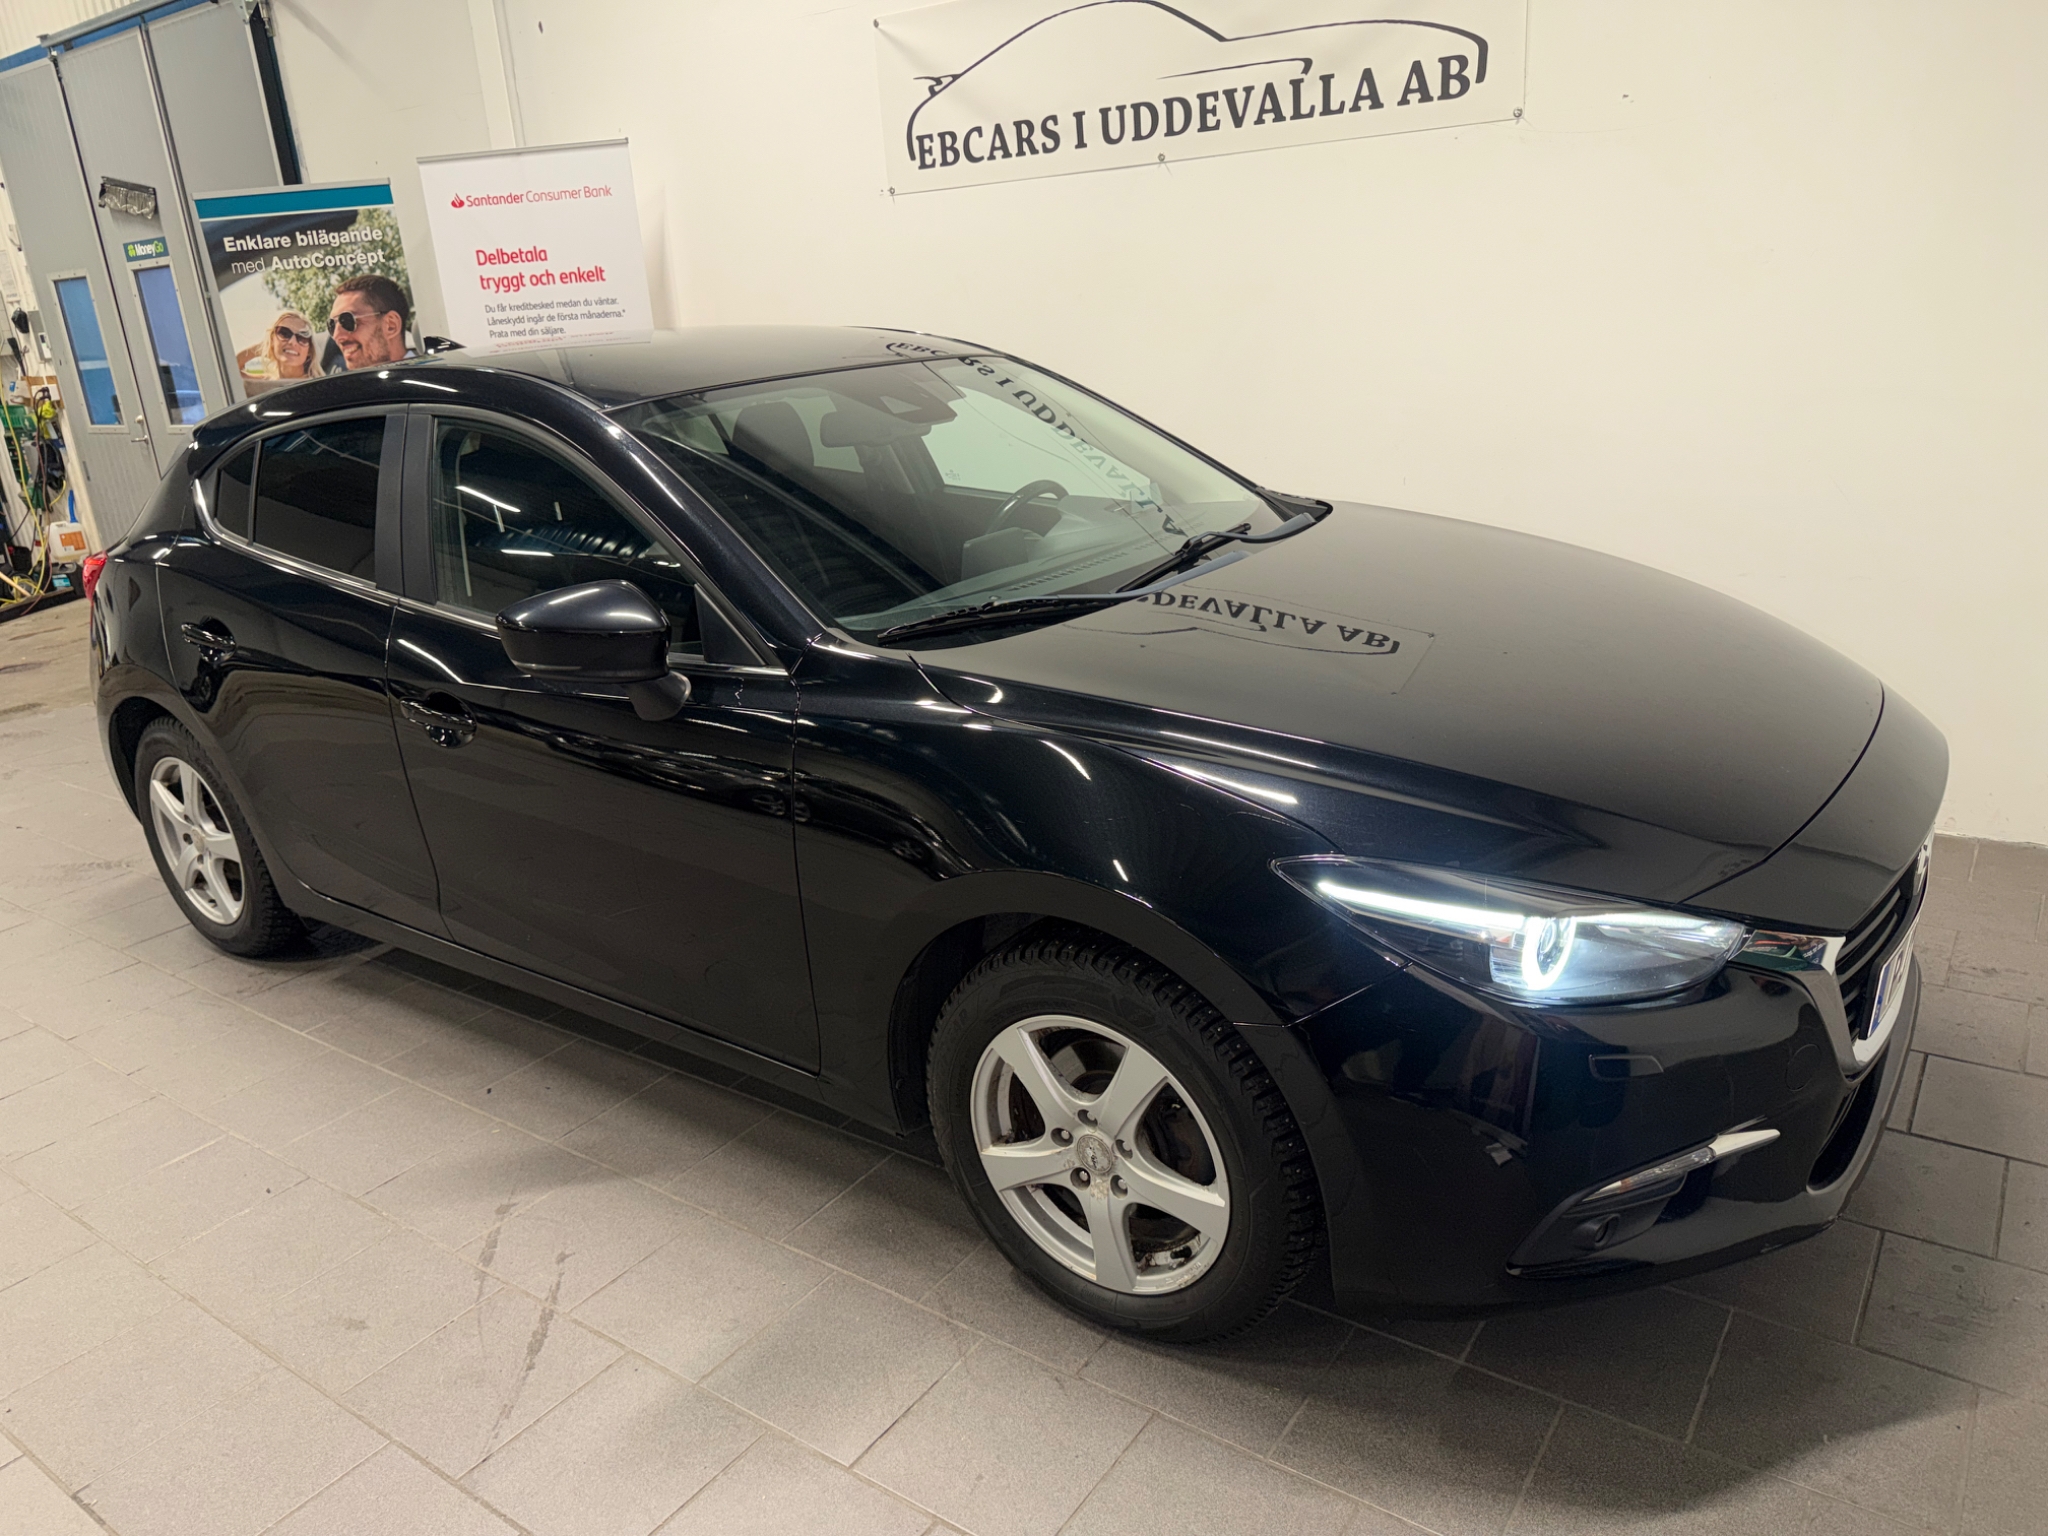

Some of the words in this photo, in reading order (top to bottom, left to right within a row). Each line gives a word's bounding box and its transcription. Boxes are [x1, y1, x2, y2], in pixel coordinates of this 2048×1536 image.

[915, 112, 1061, 170] EBCARS
[1072, 111, 1087, 149] I
[1099, 73, 1384, 146] UDDEVALLA
[1397, 54, 1471, 107] AB
[466, 192, 524, 207] Santander
[525, 187, 582, 203] Consumer
[583, 185, 613, 199] Bank
[134, 241, 164, 257] MoneyGo
[223, 234, 292, 252] Enklare
[295, 226, 383, 247] bilägande
[231, 258, 266, 274] med
[271, 249, 386, 271] AutoConcept
[475, 246, 548, 266] Delbetala
[479, 272, 526, 293] tryggt
[529, 269, 556, 287] och
[559, 265, 606, 285] enkelt
[485, 304, 496, 314] Du
[497, 303, 507, 313] får
[509, 300, 555, 312] kreditbesked
[556, 299, 582, 309] medan
[583, 297, 593, 307] du
[594, 296, 619, 306] väntar.
[487, 313, 525, 326] Låneskydd
[527, 312, 545, 326] ingår
[546, 312, 556, 323] de
[557, 310, 579, 321] första
[489, 328, 509, 339] Prata
[510, 327, 527, 337] med
[528, 326, 540, 336] din
[540, 326, 567, 337] säljare.
